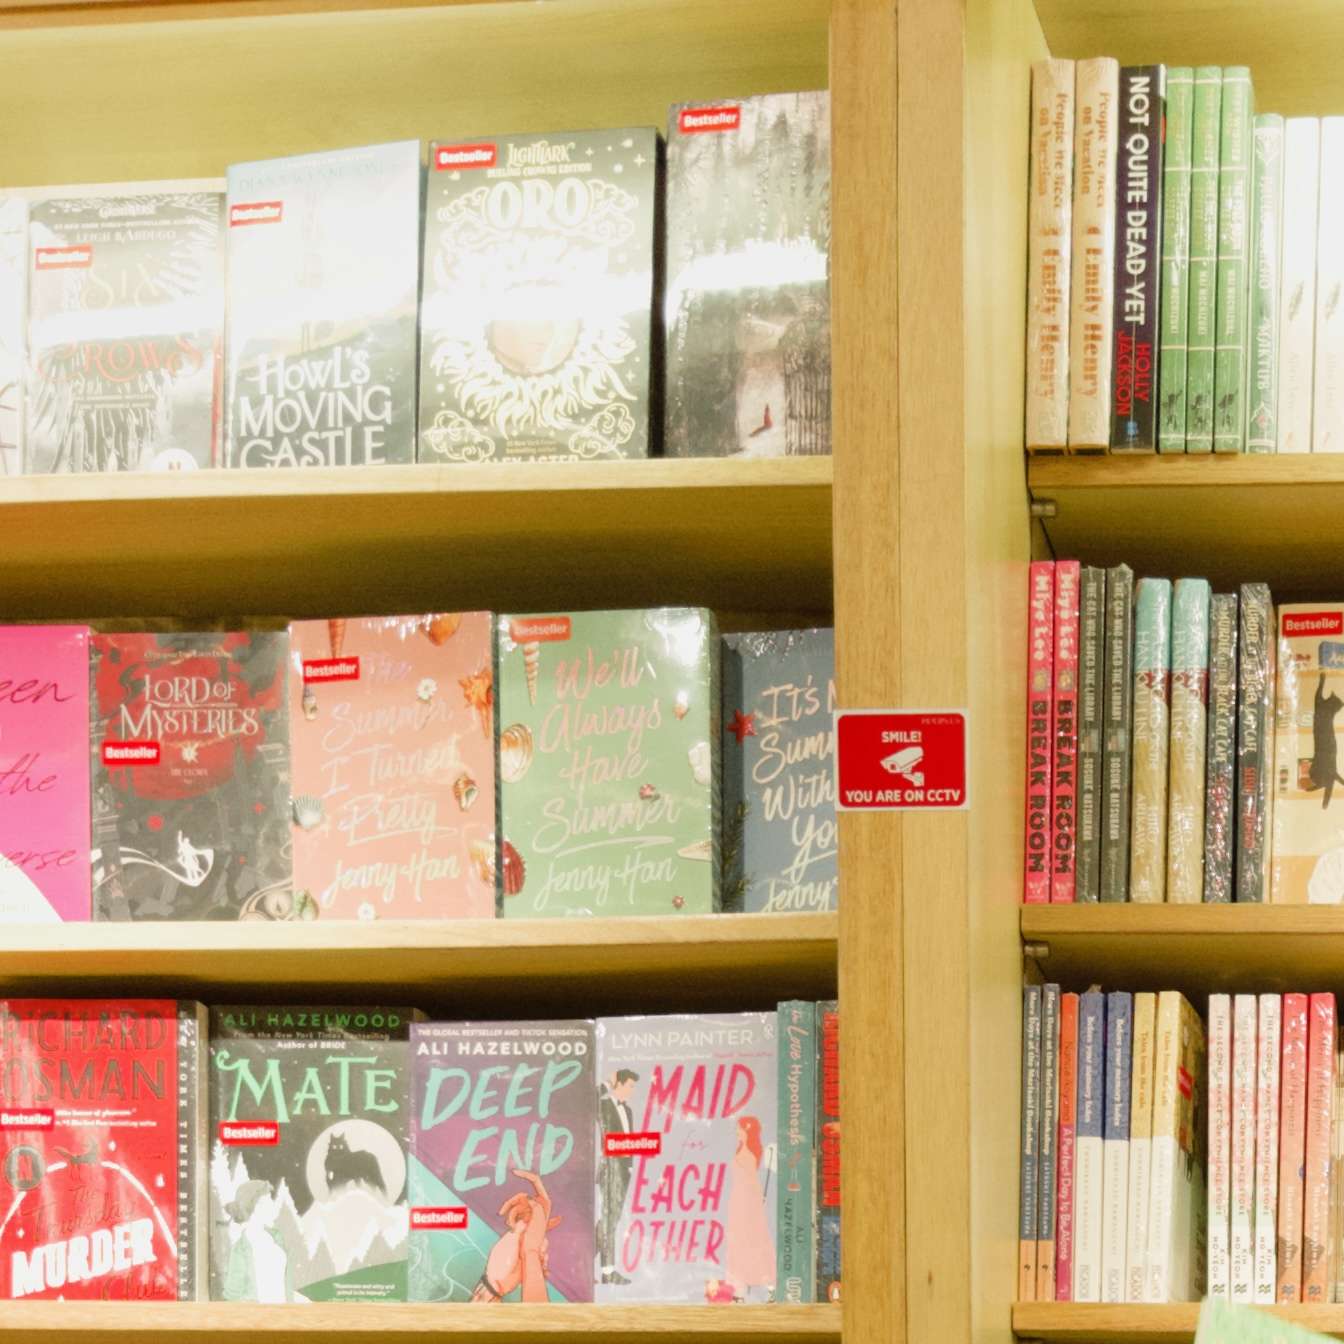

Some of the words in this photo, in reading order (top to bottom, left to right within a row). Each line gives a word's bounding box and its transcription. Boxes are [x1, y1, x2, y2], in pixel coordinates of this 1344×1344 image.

[684, 111, 736, 127] Bestseller
[1129, 76, 1149, 126] NOT
[1126, 134, 1149, 203] QUITE
[489, 178, 588, 229] ORO
[1126, 210, 1147, 276] DEAD
[1124, 279, 1145, 325] YET
[237, 346, 371, 397] Howl's
[1115, 331, 1130, 415] JACKSON
[1134, 343, 1151, 401] HOLLY
[239, 385, 393, 438] MOVING
[239, 425, 387, 469] CASTLE
[143, 674, 209, 706] LORD
[212, 684, 238, 699] OF
[555, 646, 641, 700] We'll
[120, 703, 260, 741] MYSTERIES
[540, 698, 662, 754] Always
[881, 731, 923, 744] SMILE!
[104, 746, 158, 760] Bestseller
[559, 751, 648, 792] Have
[845, 790, 873, 803] YOU
[875, 790, 902, 803] ARE
[904, 789, 924, 802] ON
[926, 789, 961, 802] CCTV
[532, 797, 681, 854] Summer
[534, 854, 611, 912] Jenny
[612, 852, 678, 905] Han
[417, 1042, 450, 1056] ALI
[458, 1042, 588, 1057] HAZELWOOD
[216, 1050, 400, 1123] MATE
[421, 1060, 582, 1130] DEEP
[640, 1063, 757, 1134] MAID
[223, 1126, 277, 1140] Bestseller
[452, 1122, 574, 1192] END
[629, 1156, 728, 1215] EACH
[621, 1218, 725, 1274] OTHER
